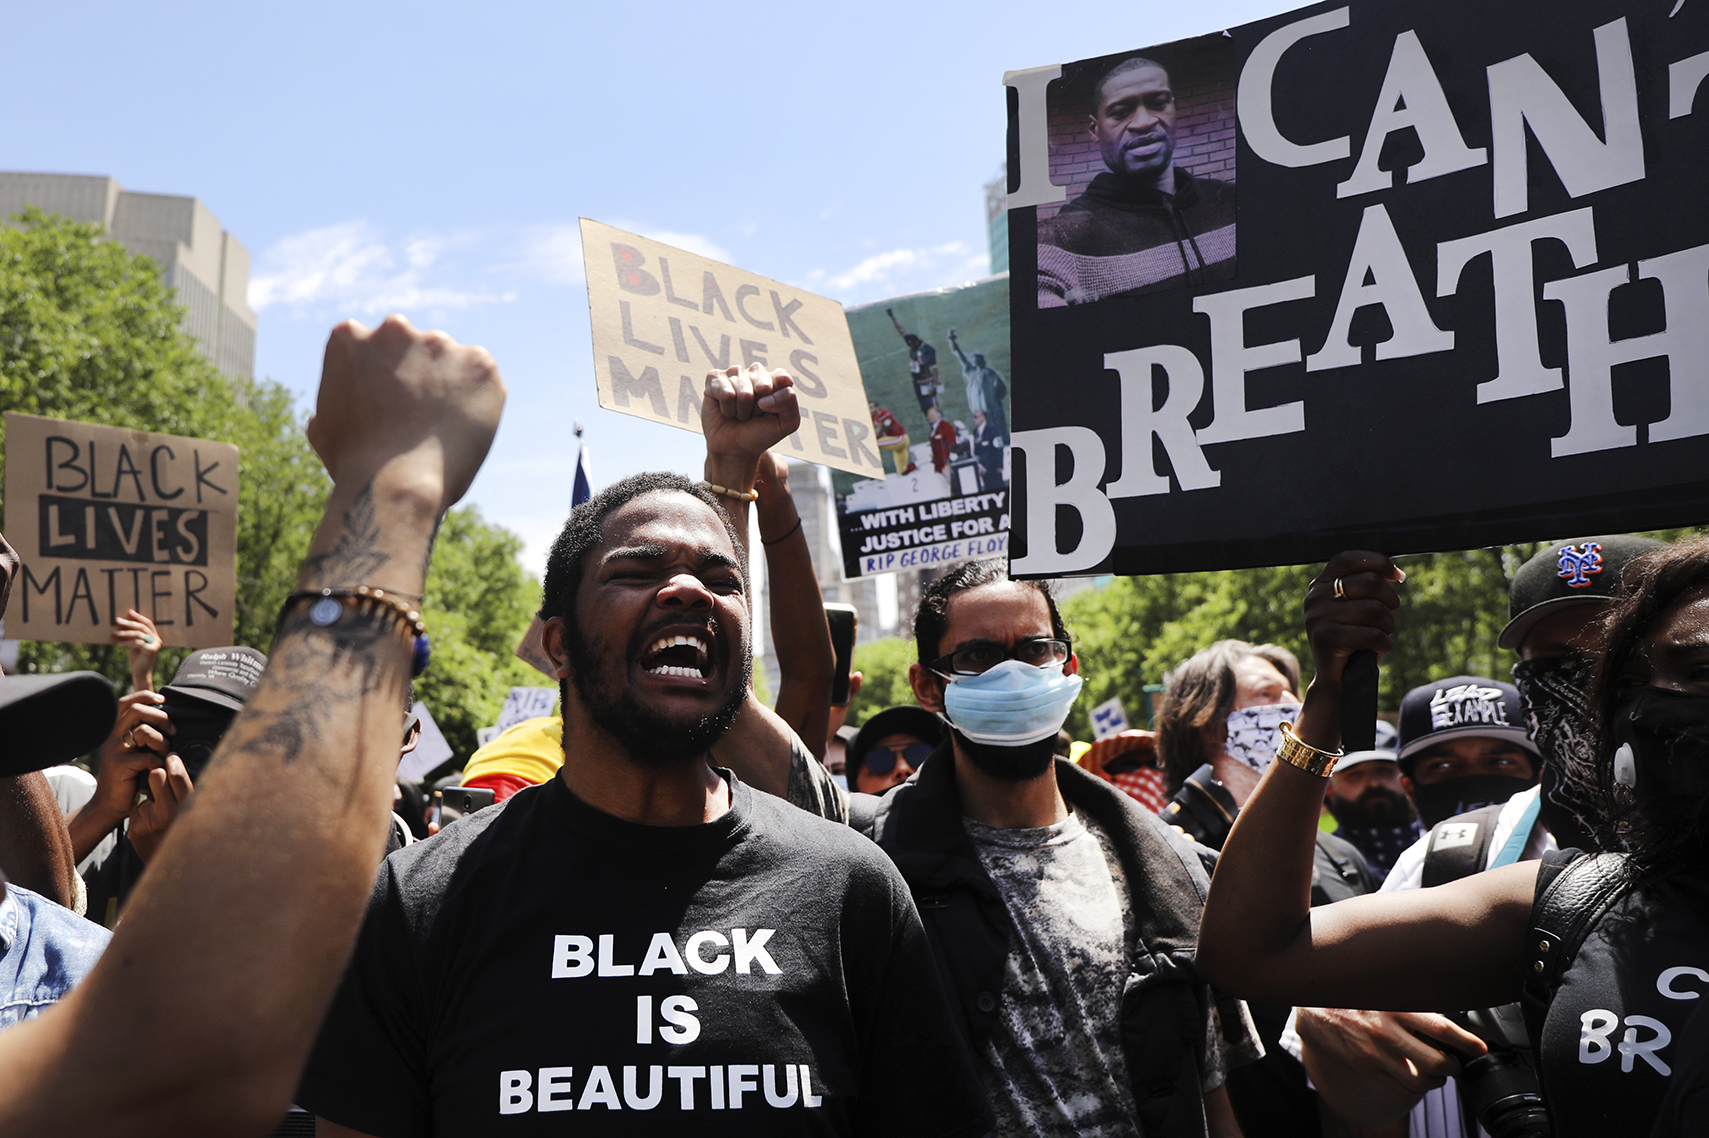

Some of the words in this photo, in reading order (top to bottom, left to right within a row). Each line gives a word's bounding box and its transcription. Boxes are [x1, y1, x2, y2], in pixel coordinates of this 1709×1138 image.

[1003, 63, 1067, 210] I
[1237, 0, 1709, 219] CAN
[610, 242, 814, 346] BLACK
[608, 355, 882, 469] MAER
[1009, 203, 1709, 577] BREATH
[46, 436, 228, 503] BLACK
[48, 504, 200, 563] LIVES
[860, 525, 947, 554] JUSTICE
[951, 516, 995, 539] FOR
[918, 491, 1006, 521] LIBERTY
[866, 553, 895, 572] RIP
[900, 542, 963, 568] GEORGE
[22, 563, 219, 626] MATTER
[551, 928, 784, 979] BLACK
[636, 995, 701, 1045] IS
[1578, 1008, 1672, 1077] BR
[499, 1063, 823, 1115] BEAUTIFUL
